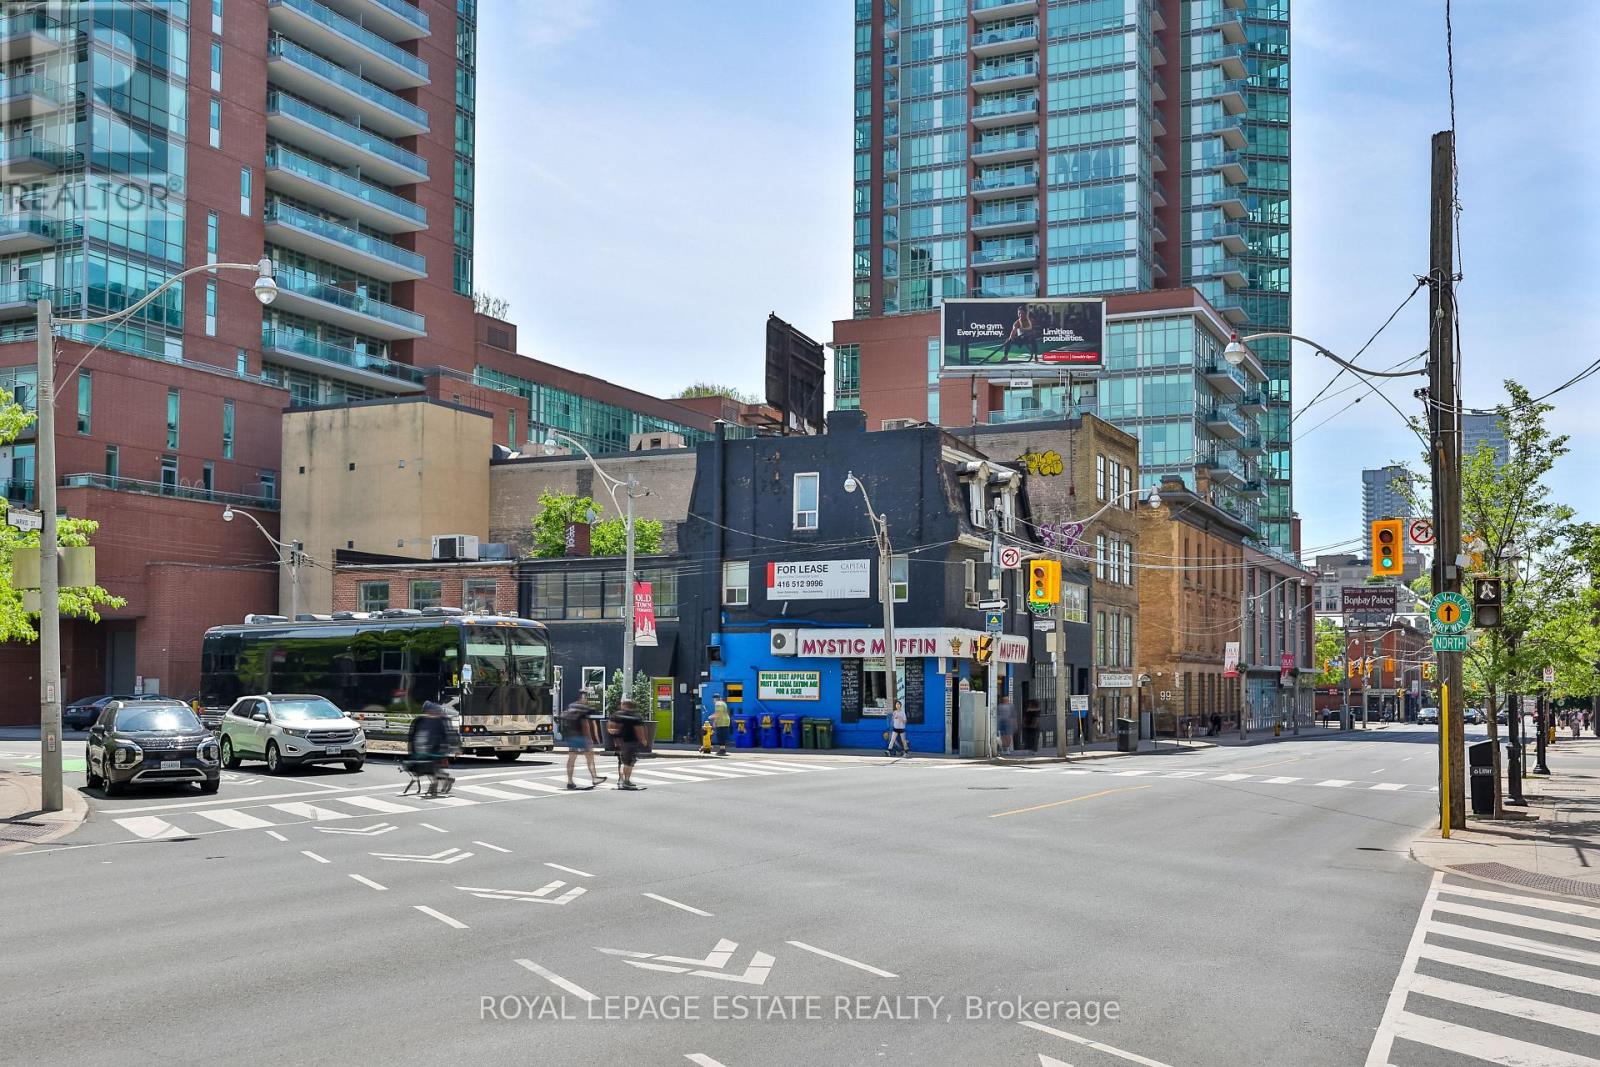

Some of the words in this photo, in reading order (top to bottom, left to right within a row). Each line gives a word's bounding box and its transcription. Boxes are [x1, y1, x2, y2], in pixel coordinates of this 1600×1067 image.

[970, 322, 986, 330] One
[986, 323, 1004, 331] gym.
[957, 329, 976, 337] Every
[976, 329, 1004, 337] journey.
[1043, 335, 1084, 343] possibilities.
[777, 565, 796, 574] FOR
[798, 564, 829, 574] LEASE
[840, 562, 867, 570] CAPITAL
[777, 580, 790, 588] 416
[791, 580, 805, 588] 512
[806, 579, 824, 588] 9996
[635, 593, 652, 602] OLD
[1344, 595, 1370, 606] Bombay
[1371, 595, 1394, 606] Palace
[1430, 596, 1442, 612] DON
[1441, 593, 1470, 612] VALLEY
[802, 639, 866, 654] MYSTIC
[1435, 637, 1464, 650] NORTH
[1000, 643, 1026, 659] MUFFIN
[1160, 690, 1171, 701] 99
